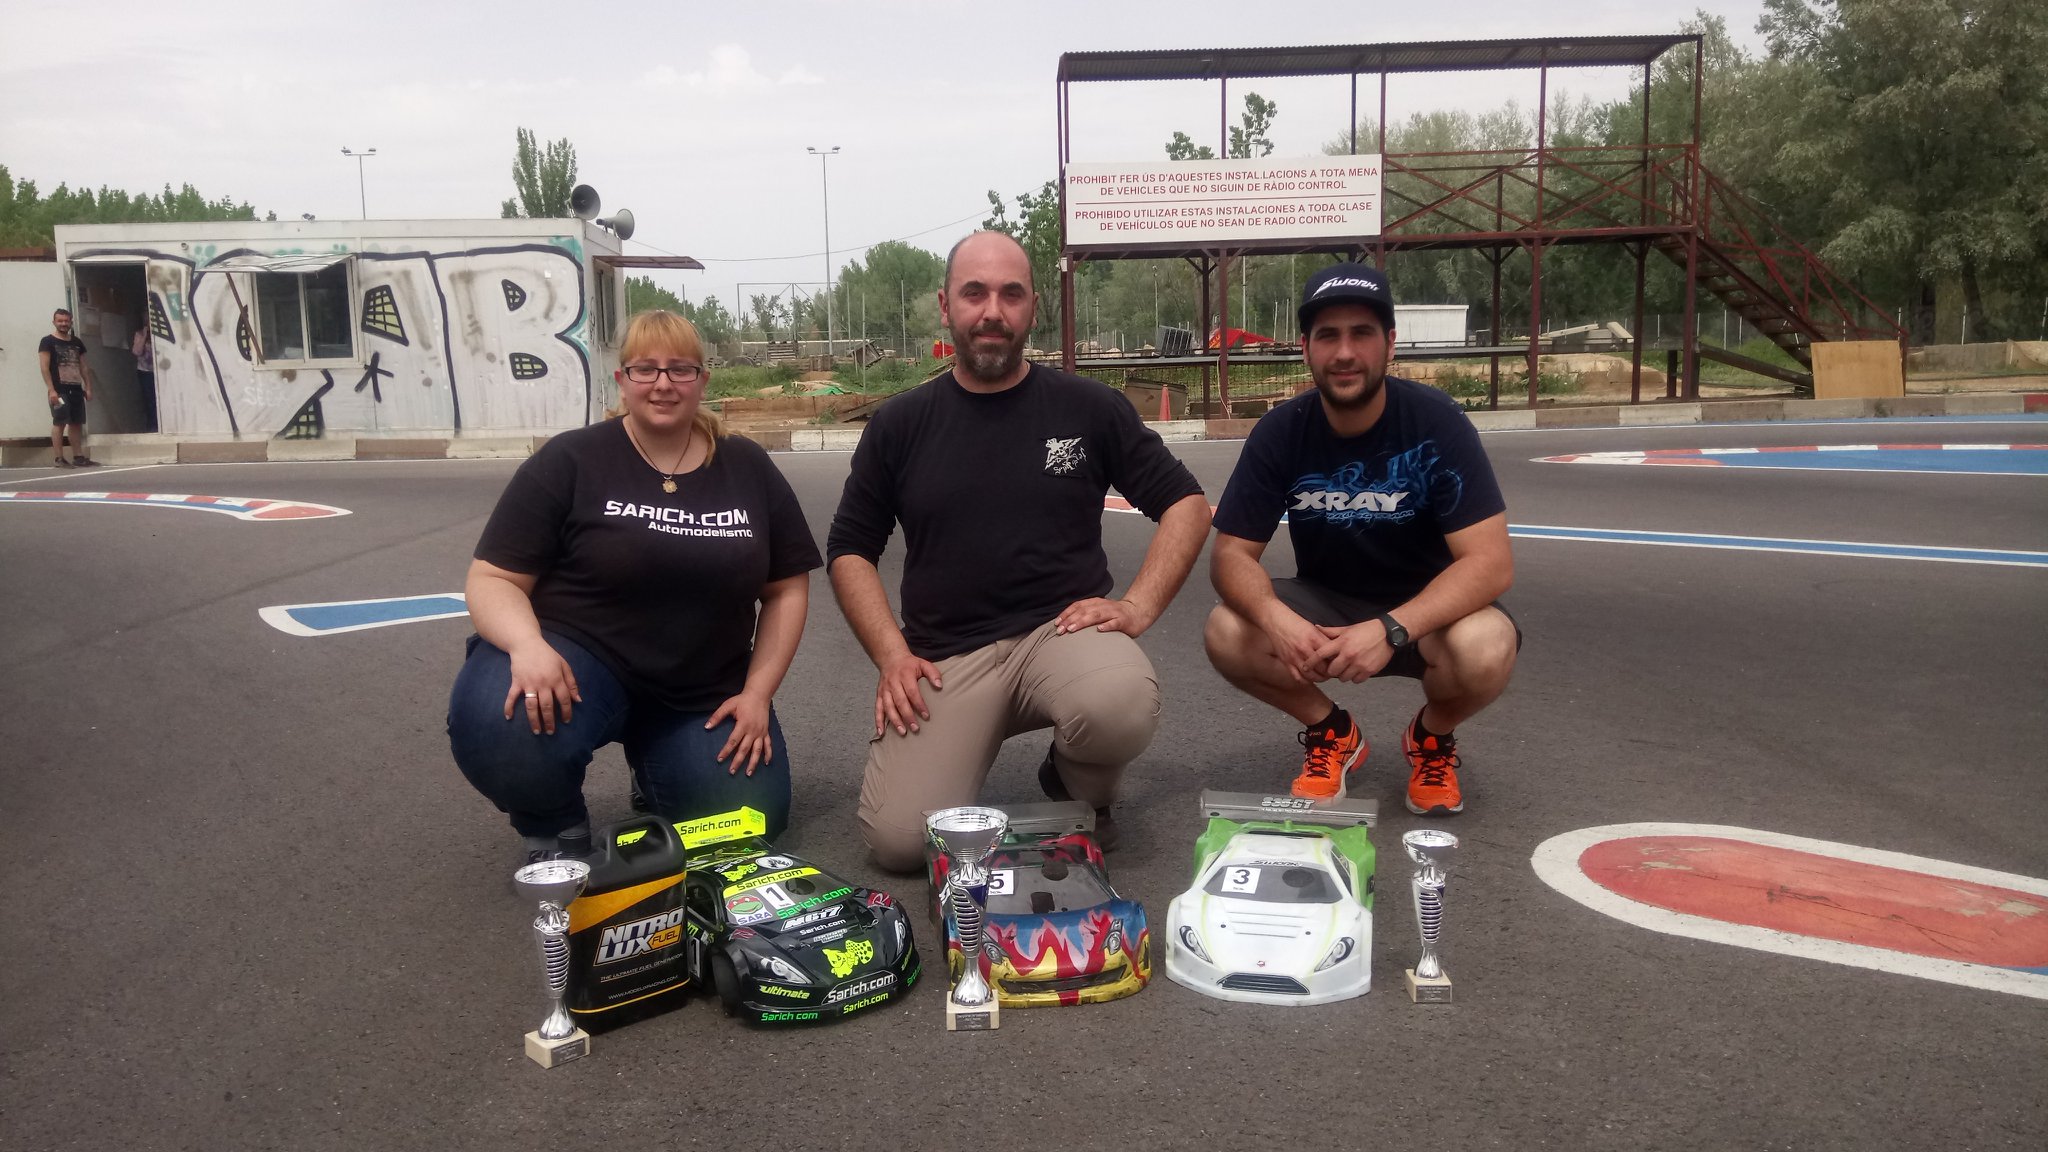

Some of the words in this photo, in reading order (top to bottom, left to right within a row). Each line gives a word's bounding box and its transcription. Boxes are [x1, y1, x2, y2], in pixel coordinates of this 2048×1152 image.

[1069, 174, 1117, 185] PROHIBIT
[1120, 174, 1139, 183] FER
[1142, 172, 1156, 183] ÚS
[1158, 172, 1222, 182] D'AQUESTES
[1310, 169, 1317, 178] A
[1320, 168, 1346, 178] TOTA
[1349, 167, 1378, 177] MENA
[1100, 187, 1114, 196] DE
[1116, 185, 1166, 195] VEHICLES
[1169, 185, 1190, 194] QUE
[1193, 184, 1208, 193] NO
[1210, 183, 1244, 193] SIGUIN
[1247, 182, 1261, 192] DE
[1264, 180, 1295, 191] RÀDIO
[1298, 180, 1347, 190] CONTROL
[1075, 210, 1131, 219] PROHIBIDO
[1134, 208, 1178, 218] UTILIZAR
[1181, 207, 1213, 217] ESTAS
[1215, 204, 1296, 215] INSTALACIONES
[1298, 204, 1305, 213] A
[1308, 203, 1336, 212] TODA
[1339, 202, 1373, 211] CLASE
[1100, 222, 1114, 231] DE
[1116, 220, 1174, 230] VEHÍCULOS
[1176, 219, 1198, 229] QUE
[1200, 219, 1215, 228] NO
[1217, 218, 1245, 227] SEAN
[1248, 217, 1261, 226] DE
[1264, 216, 1296, 226] RADIO
[1299, 215, 1348, 224] CONTROL
[1289, 490, 1410, 512] XRAY
[603, 500, 750, 527] SARICH.COM
[648, 521, 754, 538] Automodelismo
[680, 818, 741, 836] Sarich.com
[736, 869, 803, 890] Sarich.com
[989, 873, 1005, 890] 5
[1233, 869, 1251, 885] 3
[765, 886, 785, 902] 1
[776, 886, 852, 919] Sarich.com
[737, 911, 772, 925] SARA
[601, 907, 684, 947] NITRO
[799, 919, 847, 936] Sarich.com
[596, 932, 655, 964] LUX
[651, 930, 678, 946] FUEL
[759, 984, 811, 1000] ultimate
[828, 973, 895, 1004] Sarich.com
[843, 992, 889, 1014] Sarich.com
[760, 1012, 819, 1022] Sarichcom
